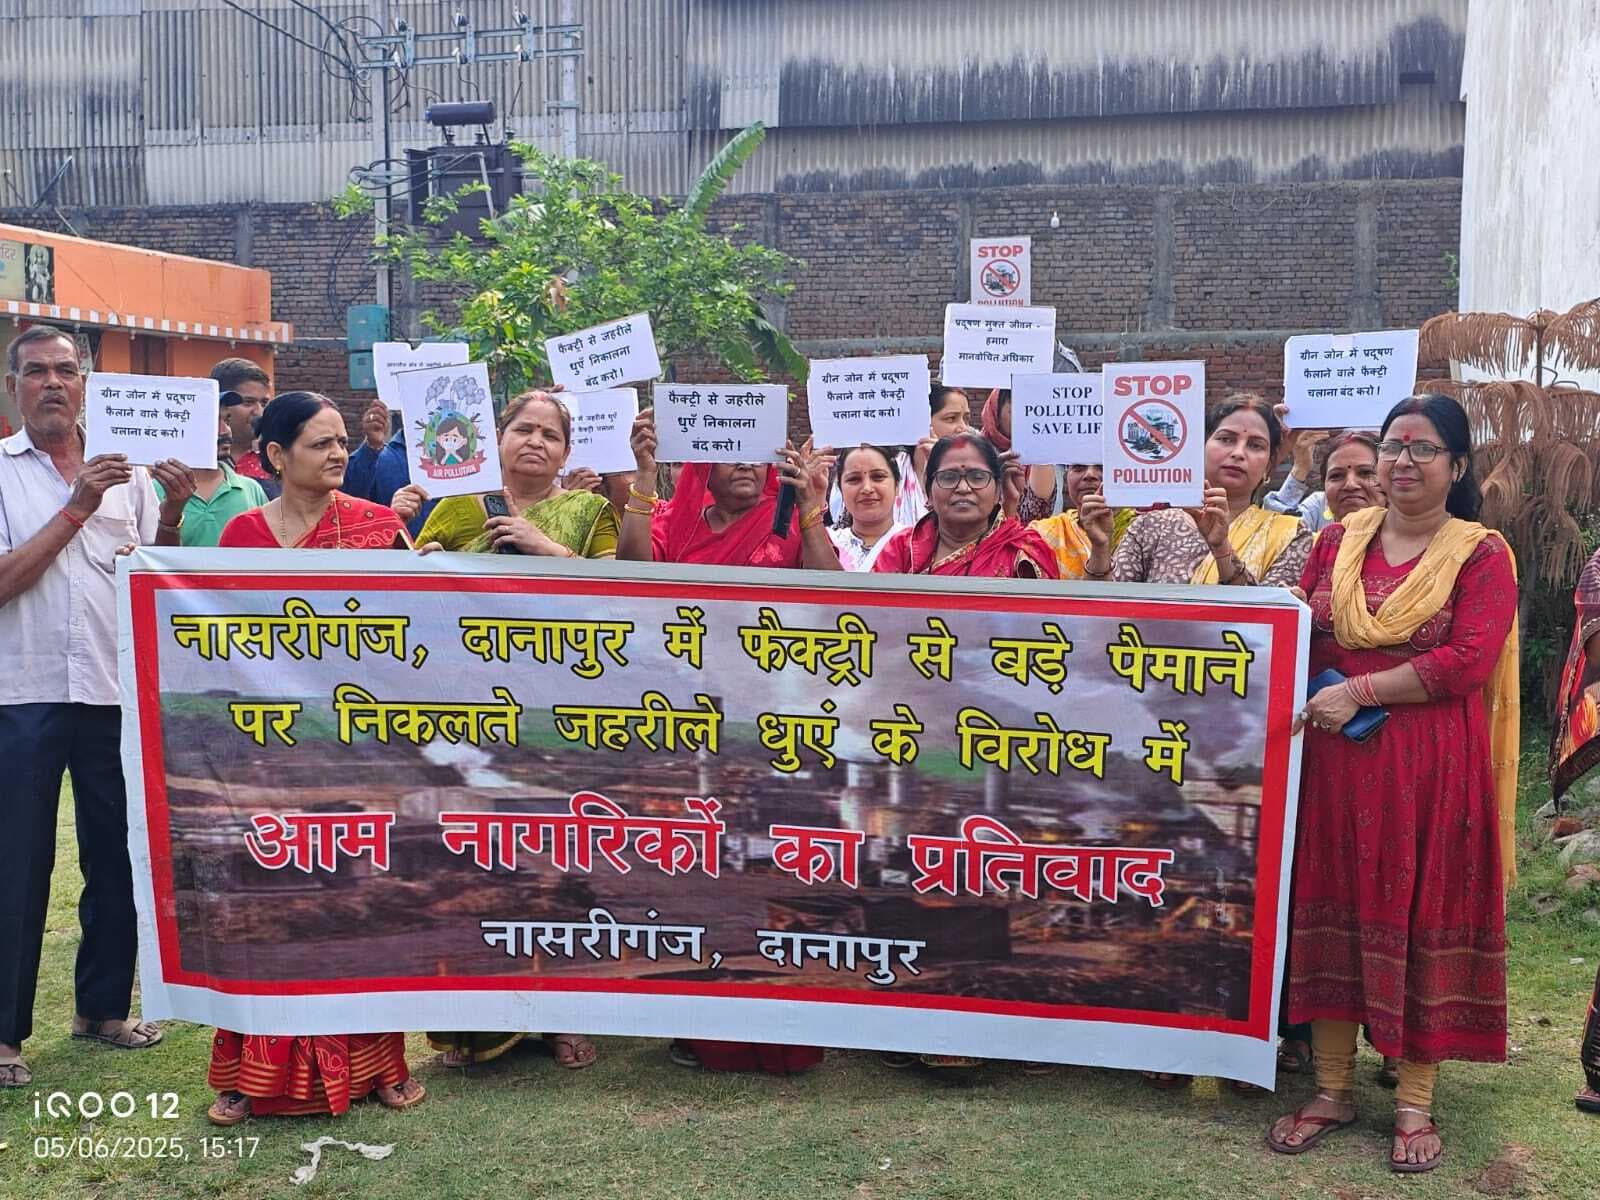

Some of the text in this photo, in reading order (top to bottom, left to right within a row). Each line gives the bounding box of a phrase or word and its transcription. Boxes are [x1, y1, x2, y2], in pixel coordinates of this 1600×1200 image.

[978, 245, 1023, 257] STOP
[955, 319, 980, 330] प्रदूषण
[985, 319, 1005, 332] मुक्त
[1009, 319, 1032, 329] जीवन
[588, 334, 596, 346] से
[601, 323, 632, 341] जहरीले
[985, 336, 1008, 345] हमारा
[589, 345, 630, 366] निकालना
[1002, 352, 1034, 363] अधिकार
[1299, 346, 1394, 361] ग्रीन जोन में प्रदूषण
[822, 372, 840, 383] ग्रीन
[844, 372, 863, 382] जोन
[881, 372, 910, 384] प्रदूषण
[1304, 368, 1332, 379] फैलाने
[1337, 366, 1356, 377] वाले
[584, 374, 599, 387] बंद
[1114, 375, 1192, 396] STOP
[100, 386, 121, 399] ग्रीन
[126, 388, 147, 400] जोन
[166, 392, 197, 405] प्रदूषण
[827, 390, 854, 401] फैलाने
[858, 389, 876, 400] वाले
[1052, 387, 1093, 399] STOP
[1307, 388, 1337, 398] चलाना
[1340, 385, 1354, 397] बंद
[669, 390, 765, 407] फैक्ट्री से जहरीले
[105, 406, 135, 418] फैलाने
[140, 408, 159, 419] वाले
[832, 410, 861, 420] चलाना
[863, 407, 877, 419] बंद
[1025, 405, 1103, 417] POLLUTIO
[677, 413, 756, 432] धुएँ निकालना
[1032, 423, 1102, 434] SAVE LIF
[110, 426, 141, 437] चलाना
[144, 425, 158, 438] बंद
[692, 437, 709, 451] बंद
[432, 464, 477, 478] AIR POLLUTION
[1113, 468, 1192, 483] POLLUTION
[171, 598, 1254, 698] नासरीगंज, दानापुर में फैक्ट्री से बड़े पैमाने
[229, 683, 1190, 786] पर निकलते जहरीले धुएं के विरोध में
[244, 791, 1175, 907] आम नागरिकों का प्रतिवाद
[480, 907, 927, 985] नासरीगंज, दानापुर
